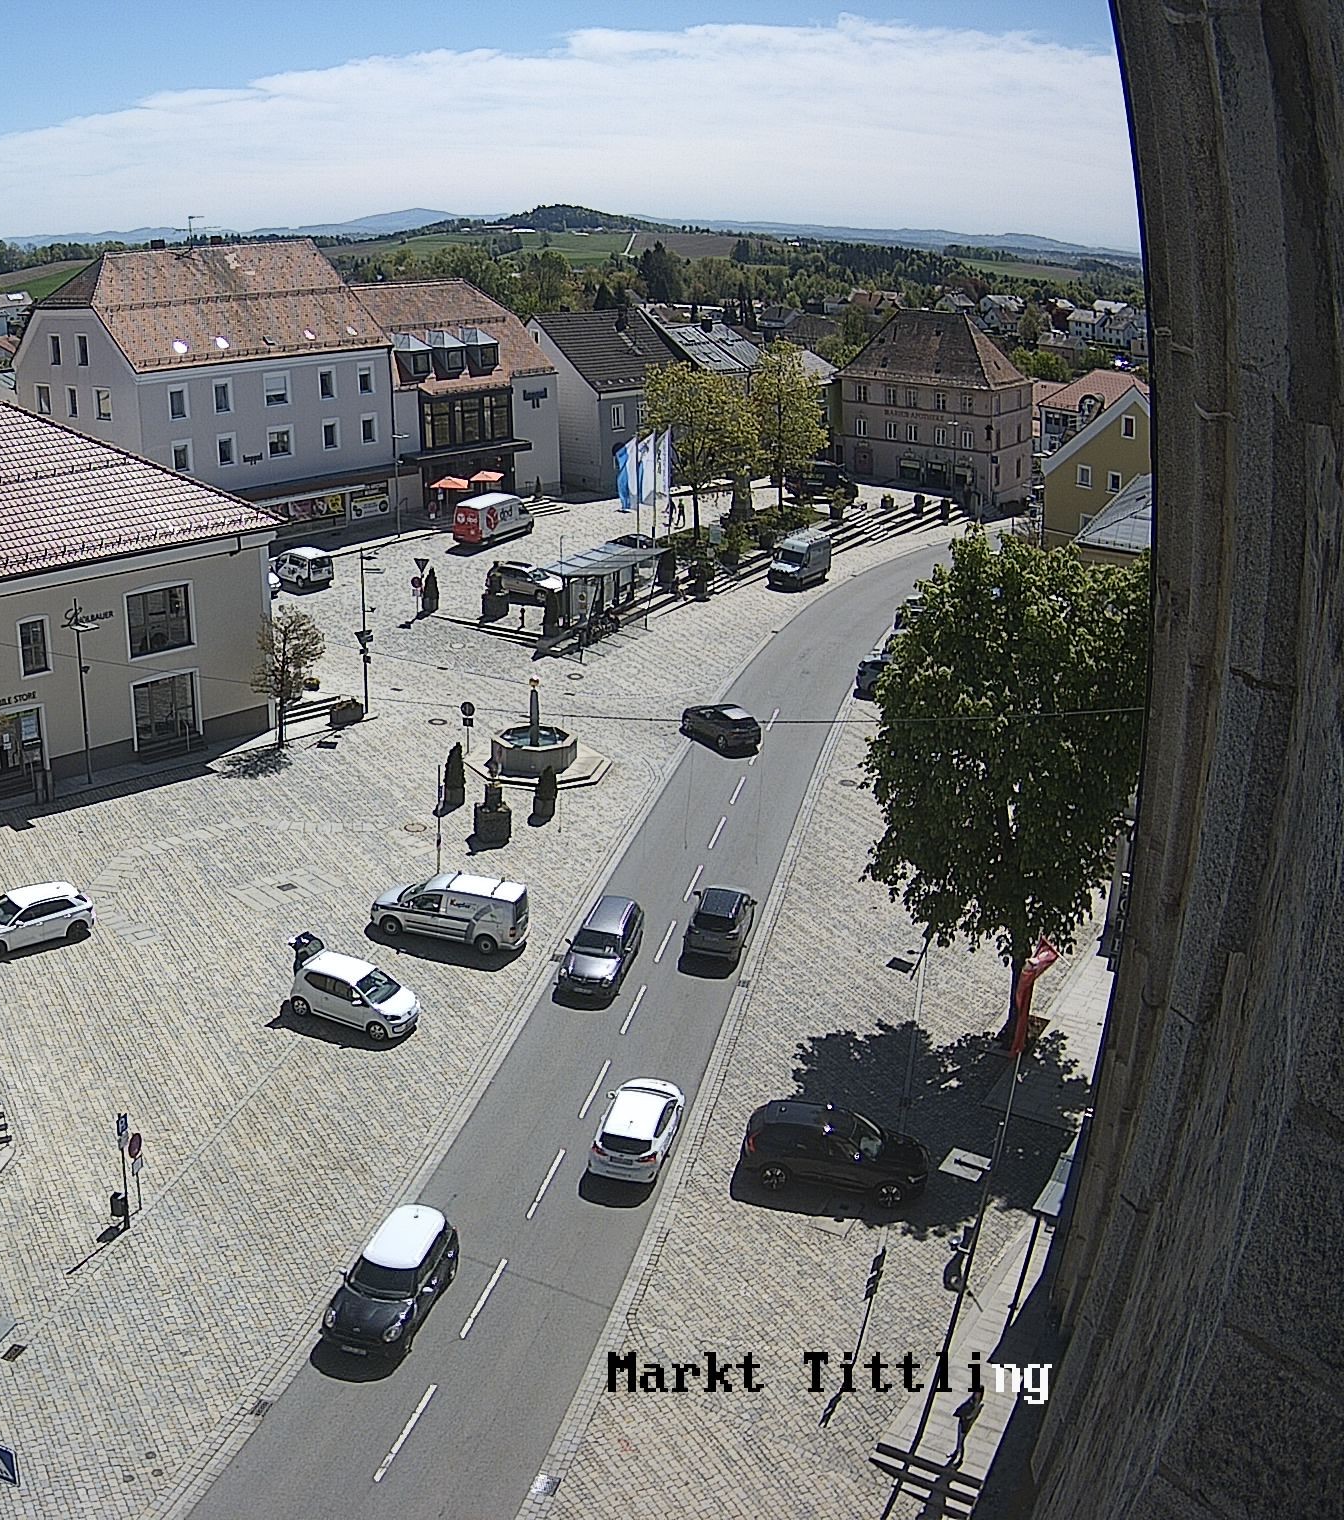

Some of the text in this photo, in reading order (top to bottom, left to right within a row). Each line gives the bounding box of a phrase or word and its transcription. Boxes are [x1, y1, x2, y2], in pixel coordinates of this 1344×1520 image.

[499, 504, 513, 522] dpd
[13, 690, 37, 704] STORE
[118, 1117, 126, 1134] P
